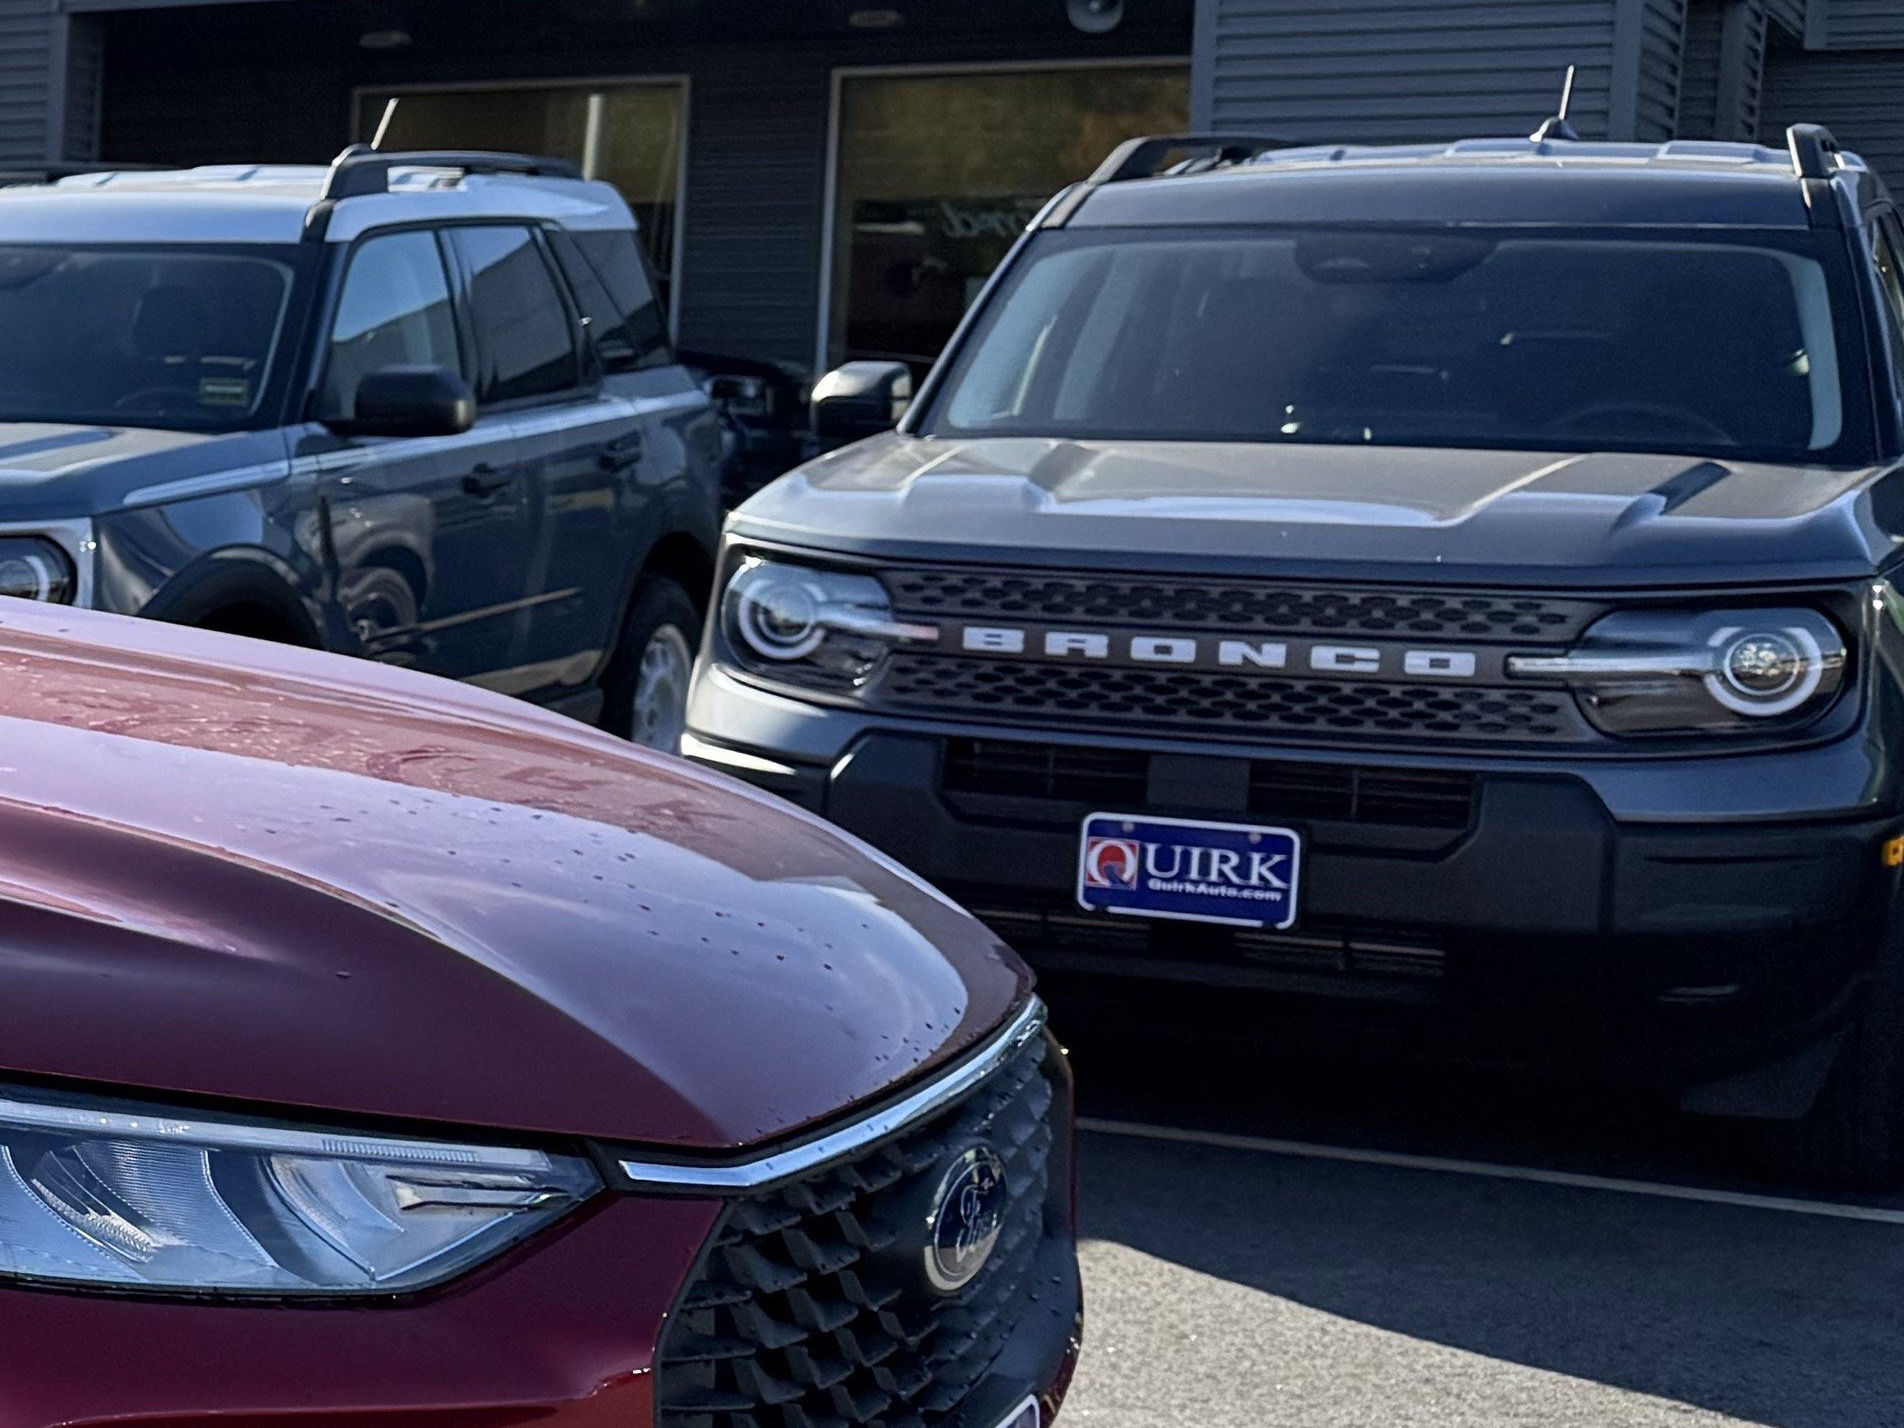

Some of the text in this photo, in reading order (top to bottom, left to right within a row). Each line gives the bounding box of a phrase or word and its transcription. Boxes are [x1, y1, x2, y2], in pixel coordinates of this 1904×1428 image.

[962, 626, 1476, 678] BRONCO
[1086, 839, 1289, 890] QUIRK
[1148, 878, 1283, 902] QuirkAuto.com
